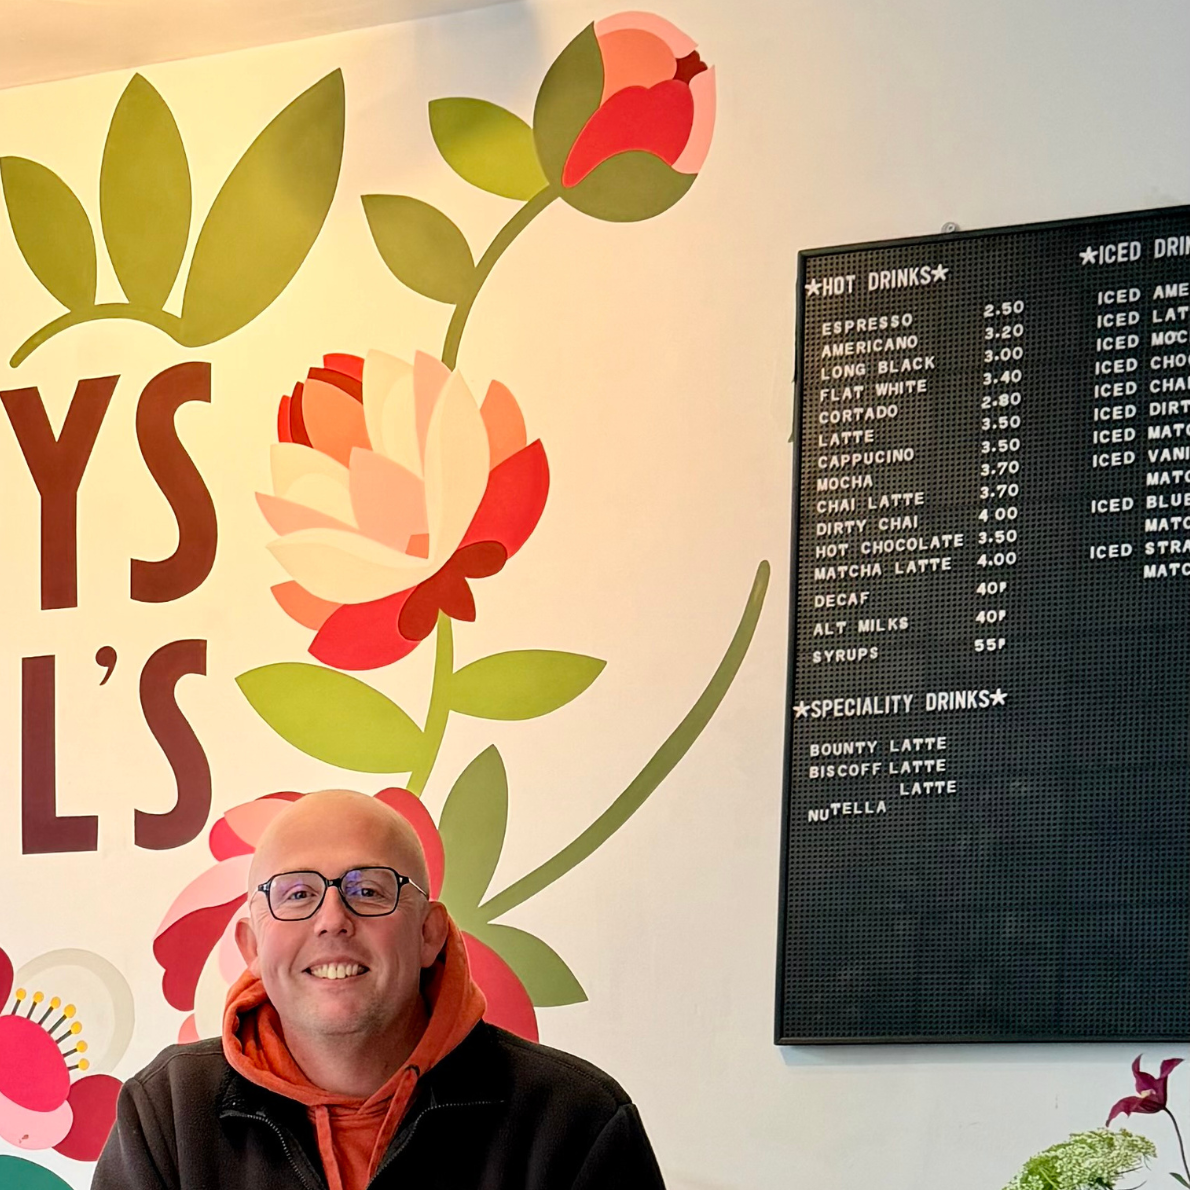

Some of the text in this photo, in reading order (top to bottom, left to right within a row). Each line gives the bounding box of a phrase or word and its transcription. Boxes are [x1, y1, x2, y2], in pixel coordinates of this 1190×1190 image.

[1098, 241, 1142, 265] ICED
[823, 265, 931, 296] HOT DRINKS
[1098, 287, 1141, 306] ICED
[822, 300, 1024, 336] ESPRESSO 2.50
[1097, 311, 1140, 329] ICED
[821, 324, 1024, 358] AMERICANO 3.20
[1096, 334, 1139, 352] ICED
[821, 346, 1023, 381] LONG BLACK 3.00
[1095, 353, 1190, 375] ICED CHO
[820, 369, 1022, 401] FLAT WHITE 3.40
[1094, 381, 1137, 399] ICED
[819, 392, 1021, 424] CORTADO 2.80
[1094, 404, 1137, 421] ICED
[818, 415, 1021, 447] LATTE 3.50
[1093, 427, 1136, 444] ICED
[818, 438, 1020, 469] CAPPUCINO 3.50
[1092, 451, 1135, 468] ICED
[817, 461, 1019, 491] MOCHA 3.70
[817, 484, 1019, 513] CHAI LATTE 3.70
[1091, 497, 1134, 514] ICED
[816, 519, 866, 536] DIRTY
[878, 515, 918, 530] CHAI
[815, 530, 1017, 558] HOT CHOCOLATE 3.50
[1090, 543, 1133, 559] ICED
[814, 552, 1017, 580] MATCHA LATTE 4.00
[814, 591, 869, 608] DECAF
[813, 621, 847, 636] ALT
[858, 617, 909, 633] MILKS
[812, 646, 879, 664] SYRUPS
[811, 689, 990, 718] SPECIALITY DRINKS
[810, 737, 947, 757] BOUNTY LATTE
[809, 759, 946, 779] BISCOFF LATTE
[900, 780, 957, 796] LATTE
[808, 801, 887, 822] NUTELLA
